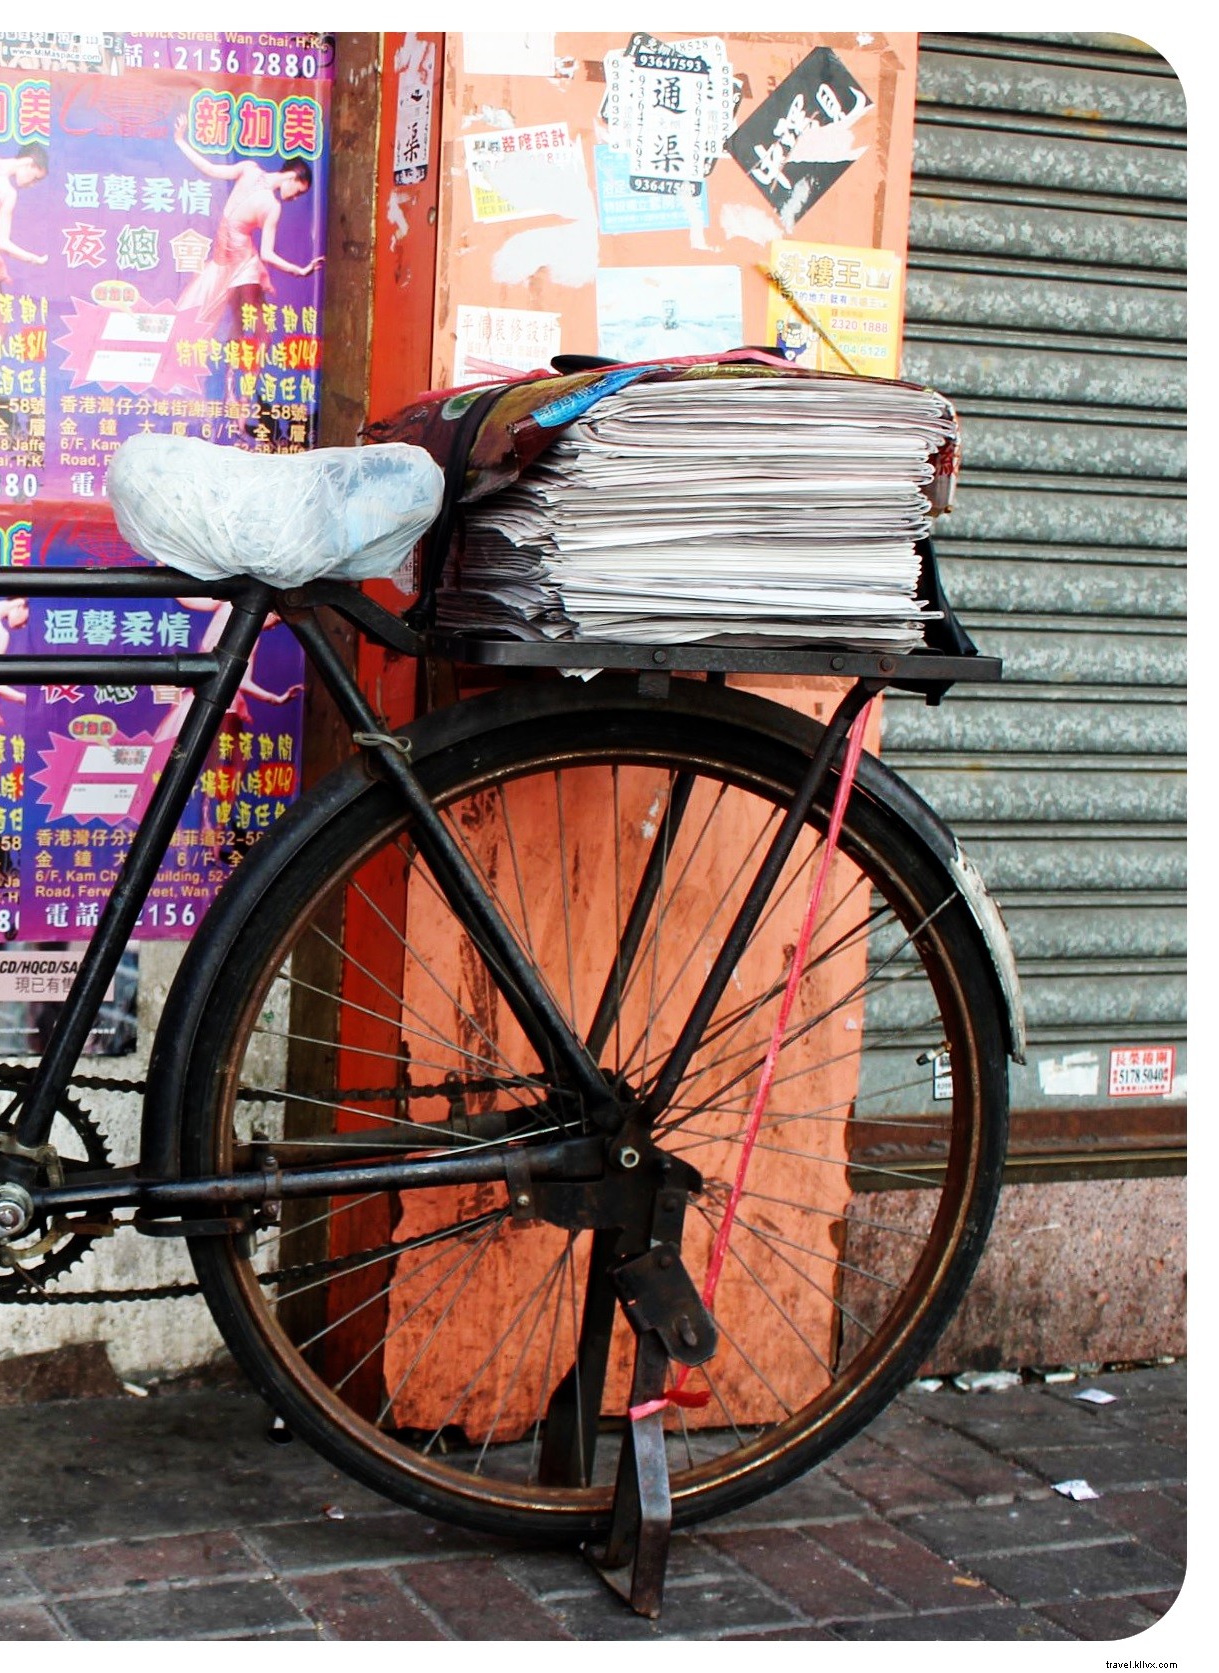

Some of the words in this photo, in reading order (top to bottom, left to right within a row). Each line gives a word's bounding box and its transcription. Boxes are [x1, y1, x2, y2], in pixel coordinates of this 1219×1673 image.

[226, 34, 252, 45] Wan
[259, 35, 292, 48] Chai,
[174, 46, 240, 73] 2156
[252, 52, 316, 78] 2880
[639, 56, 703, 72] 93647593
[191, 93, 320, 156] 新加美
[633, 177, 697, 195] 9364753
[62, 222, 213, 273] 夜總會
[831, 319, 858, 331] 2320
[863, 322, 888, 333] 1888
[13, 440, 45, 453] Jaffe
[91, 440, 121, 451] Kam
[60, 454, 100, 468] Road,
[66, 871, 96, 883] Kam
[36, 886, 75, 900] Road,
[181, 886, 209, 898] Wan
[0, 960, 82, 976] CD/HQCD/SA
